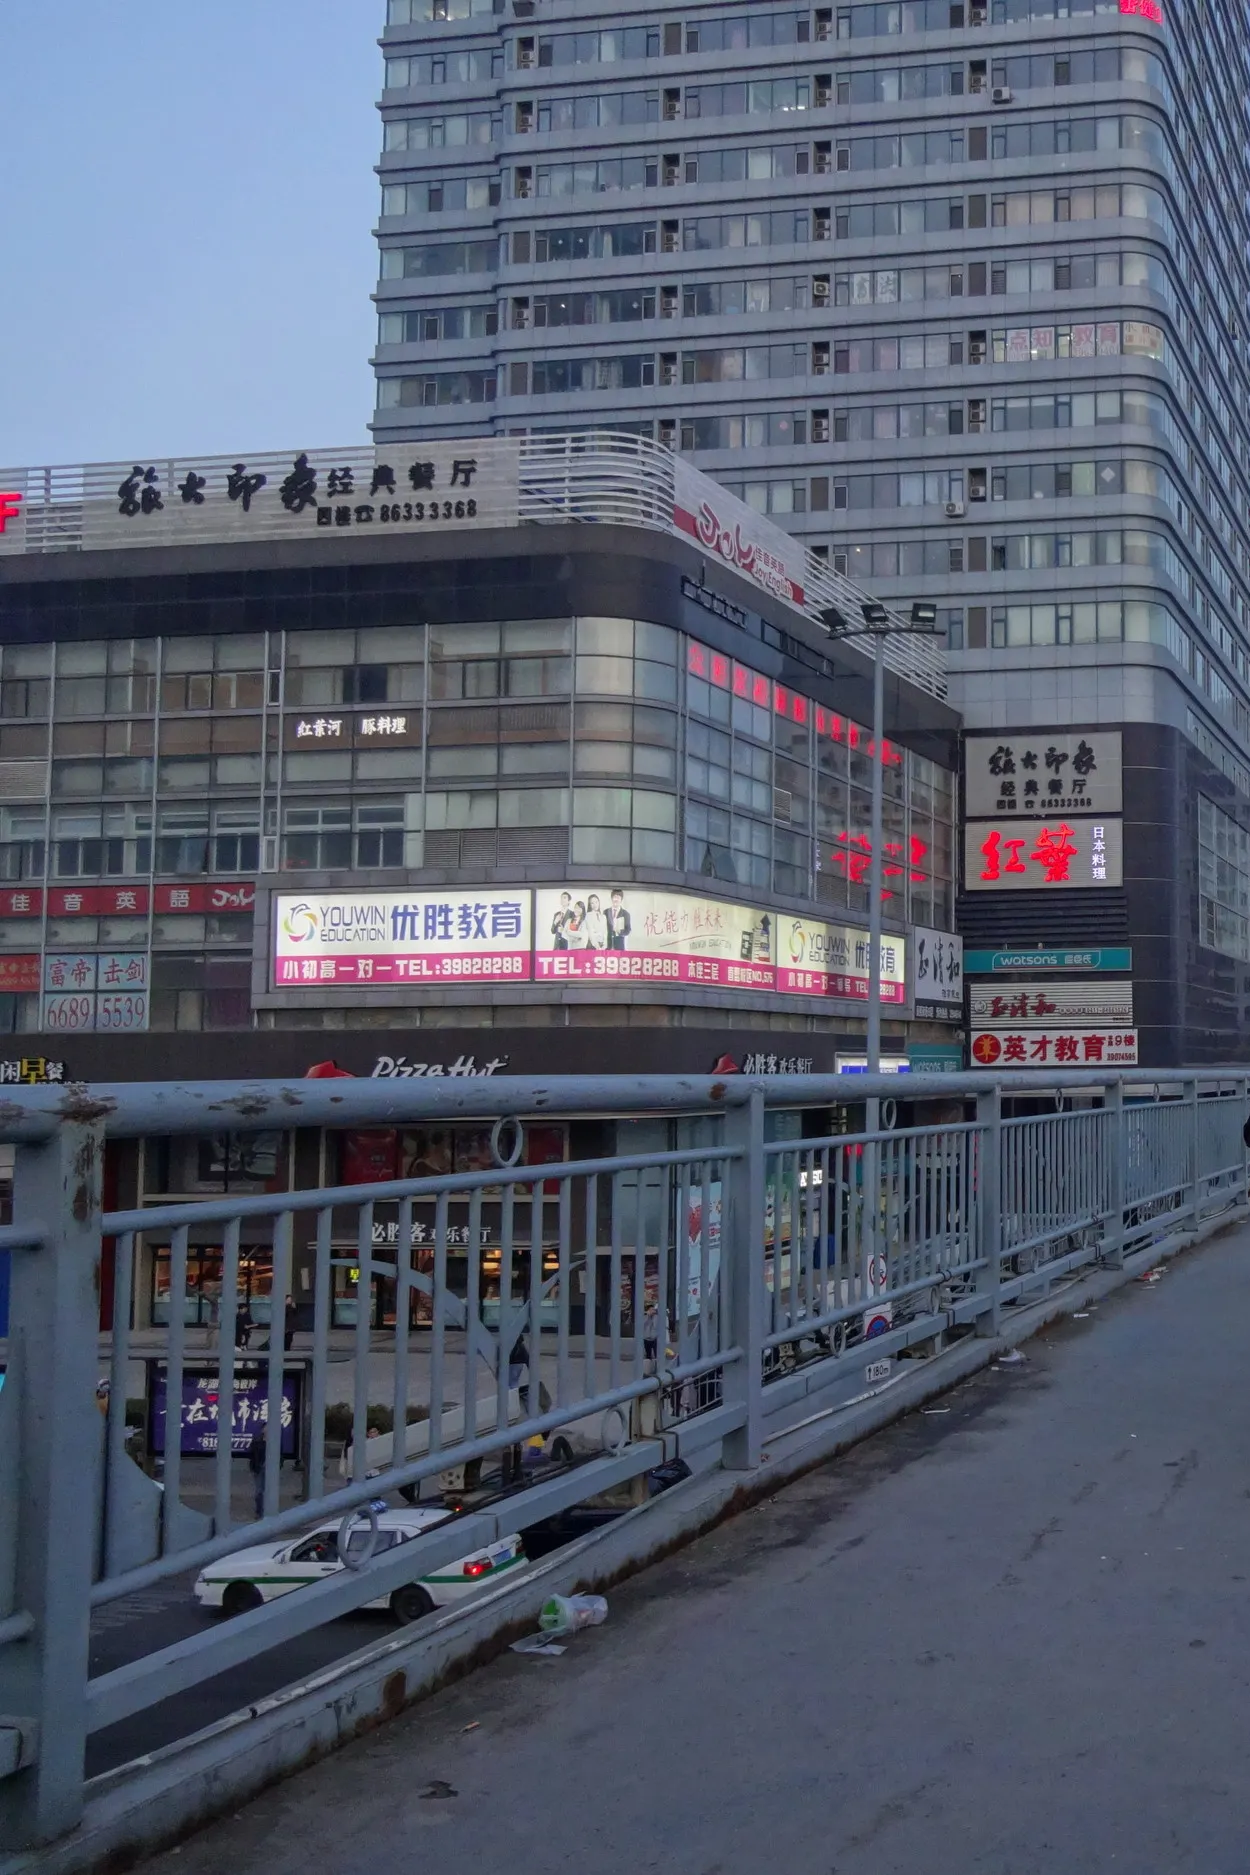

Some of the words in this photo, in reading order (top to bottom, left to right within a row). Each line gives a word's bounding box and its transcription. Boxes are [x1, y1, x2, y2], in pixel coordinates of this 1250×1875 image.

[327, 459, 478, 498] 经典餐厅
[380, 499, 477, 523] 86333368
[1000, 779, 1087, 796] 经典餐厅
[1092, 826, 1107, 880] 日本料理
[320, 905, 386, 927] YOUWIN
[391, 901, 522, 941] 优胜教育
[320, 927, 386, 942] EDUCATION
[809, 932, 851, 953] YOUWIN
[283, 959, 392, 980] 小初高一对一
[395, 956, 522, 977] TEL:39828288
[538, 955, 680, 977] TEL:39828288
[688, 960, 720, 981] 本座三层
[809, 950, 851, 966] EDUCATION
[49, 957, 146, 988] 富帝击剑
[1003, 1035, 1106, 1061] 英才教育
[371, 1056, 444, 1078] Pizza
[448, 1055, 507, 1077] Hut
[743, 1053, 778, 1075] 必胜客
